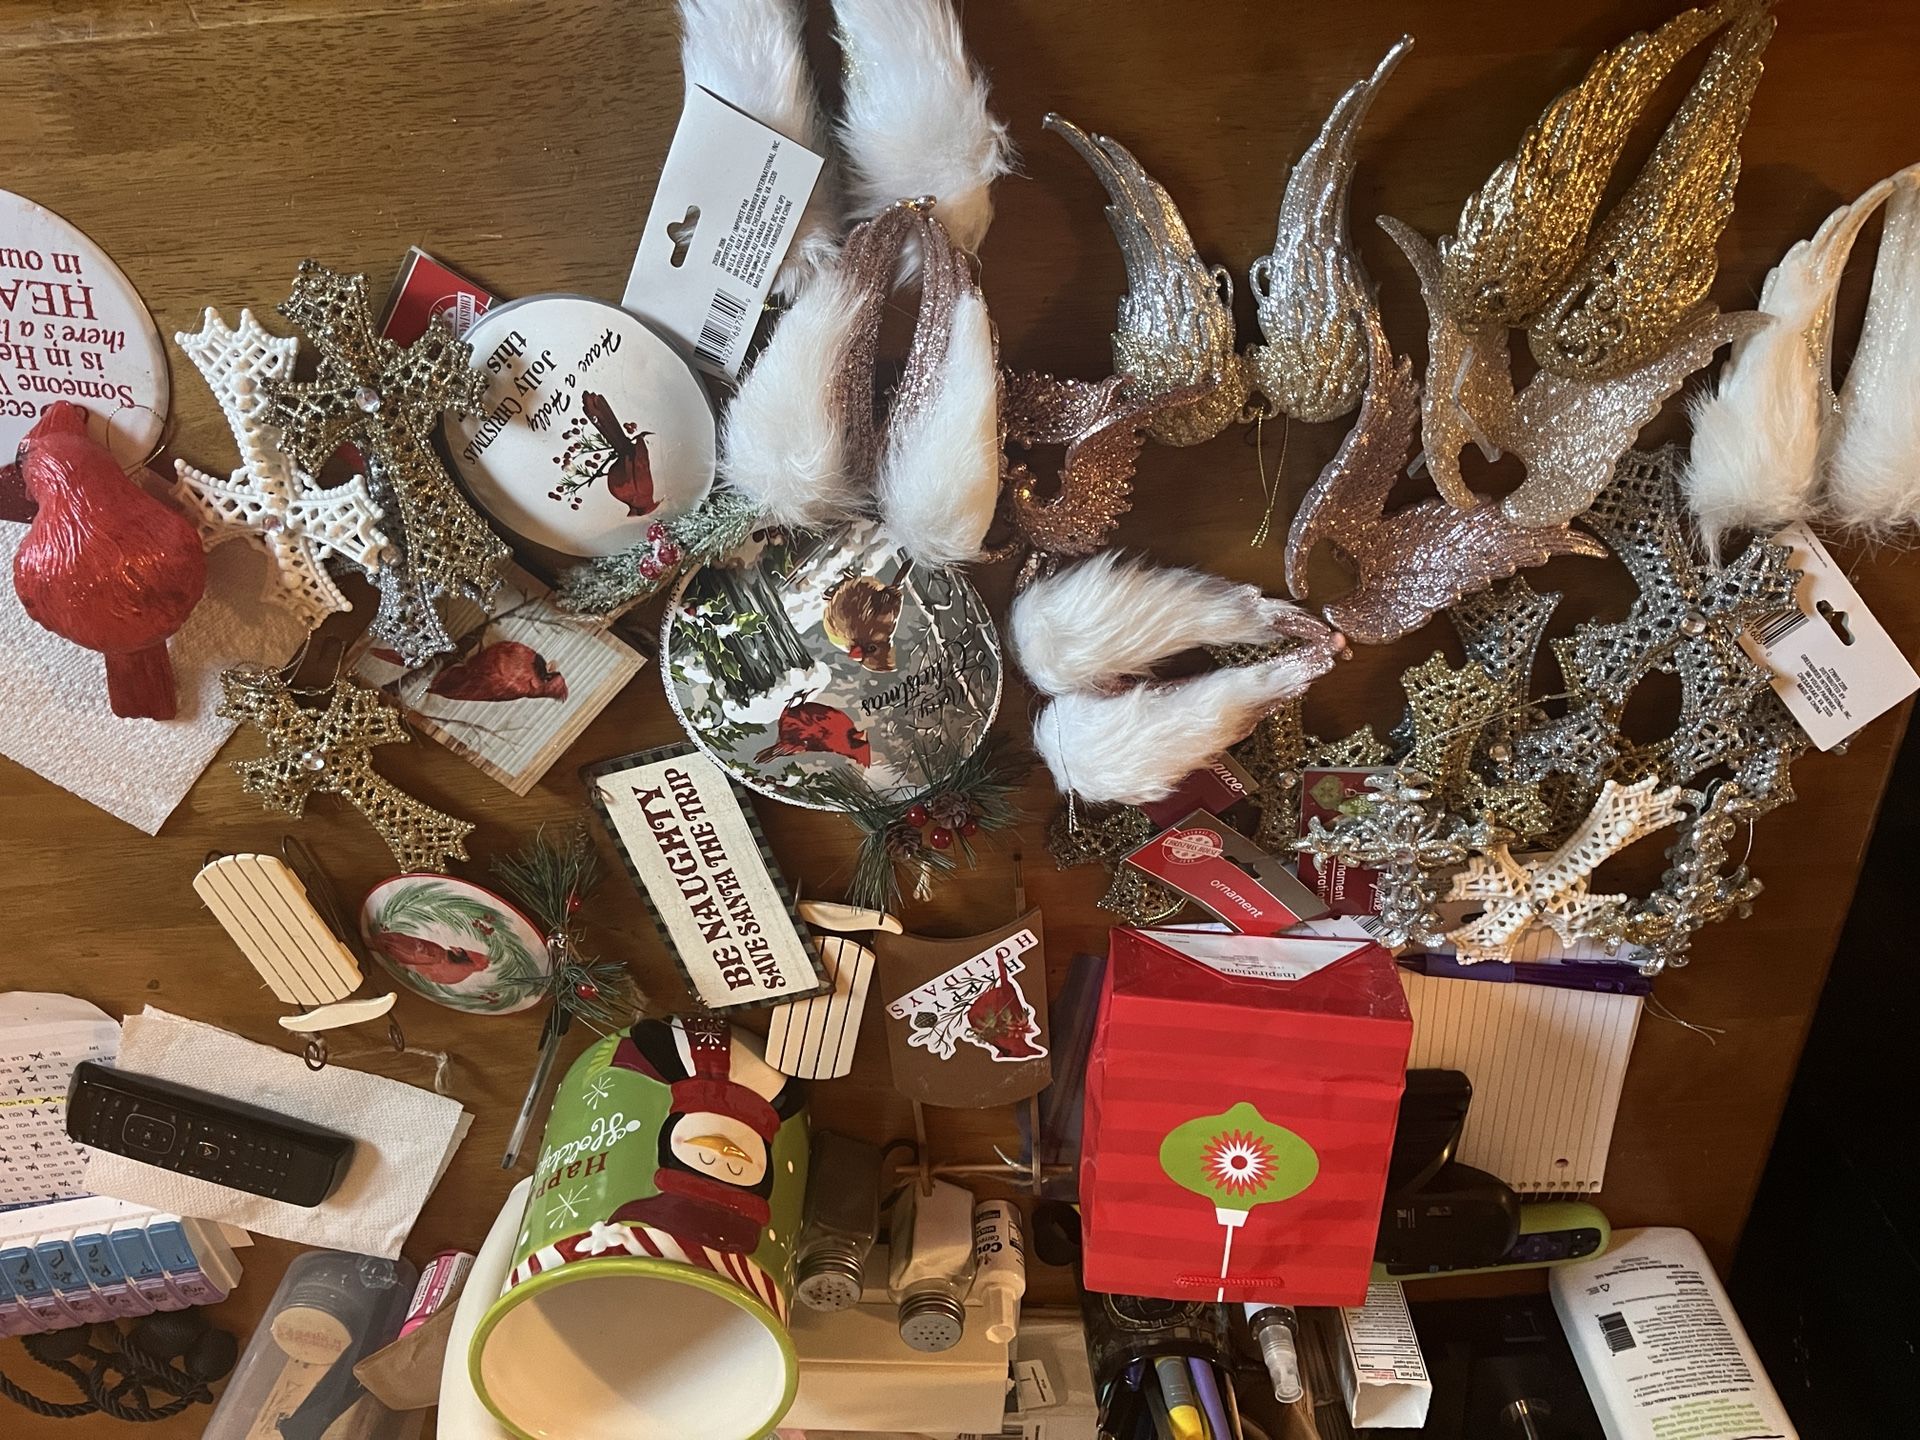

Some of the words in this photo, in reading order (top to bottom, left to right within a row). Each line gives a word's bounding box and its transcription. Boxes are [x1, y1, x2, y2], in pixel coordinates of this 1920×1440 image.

[744, 193, 760, 224] GREENBRIER
[770, 214, 778, 222] BC
[778, 215, 786, 224] EN
[781, 199, 792, 216] CHINE
[718, 242, 733, 268] IMPORTED
[728, 234, 736, 243] BY
[740, 198, 749, 210] PAR
[735, 252, 746, 269] VOLVO
[764, 185, 771, 194] VA
[741, 252, 754, 274] CANADA
[750, 242, 758, 251] AU
[760, 251, 771, 268] CHINA
[51, 253, 82, 283] in
[739, 273, 746, 281] IN
[752, 273, 762, 288] MADE
[19, 320, 34, 338] a
[457, 294, 472, 331] CHRISTM
[44, 323, 125, 354] there's
[483, 328, 531, 378] this
[576, 328, 621, 373] Have
[44, 347, 73, 375] in
[80, 351, 104, 378] is
[508, 345, 560, 400] Jolly
[17, 374, 134, 408] Someone
[562, 372, 579, 389] a
[525, 389, 569, 433] Holly
[860, 640, 985, 716] Christmas
[663, 768, 706, 823] TRIP
[689, 820, 727, 869] THE
[630, 784, 733, 943] NAUGHTY
[1334, 861, 1347, 900] nament
[711, 867, 761, 937] SANTA
[1207, 876, 1265, 920] ornament
[710, 942, 755, 990] BE
[743, 935, 786, 989] SAVE
[889, 932, 1032, 1017] HOLIDAYS
[1219, 967, 1295, 979] Inspirations
[932, 958, 1021, 1012] HAPPY
